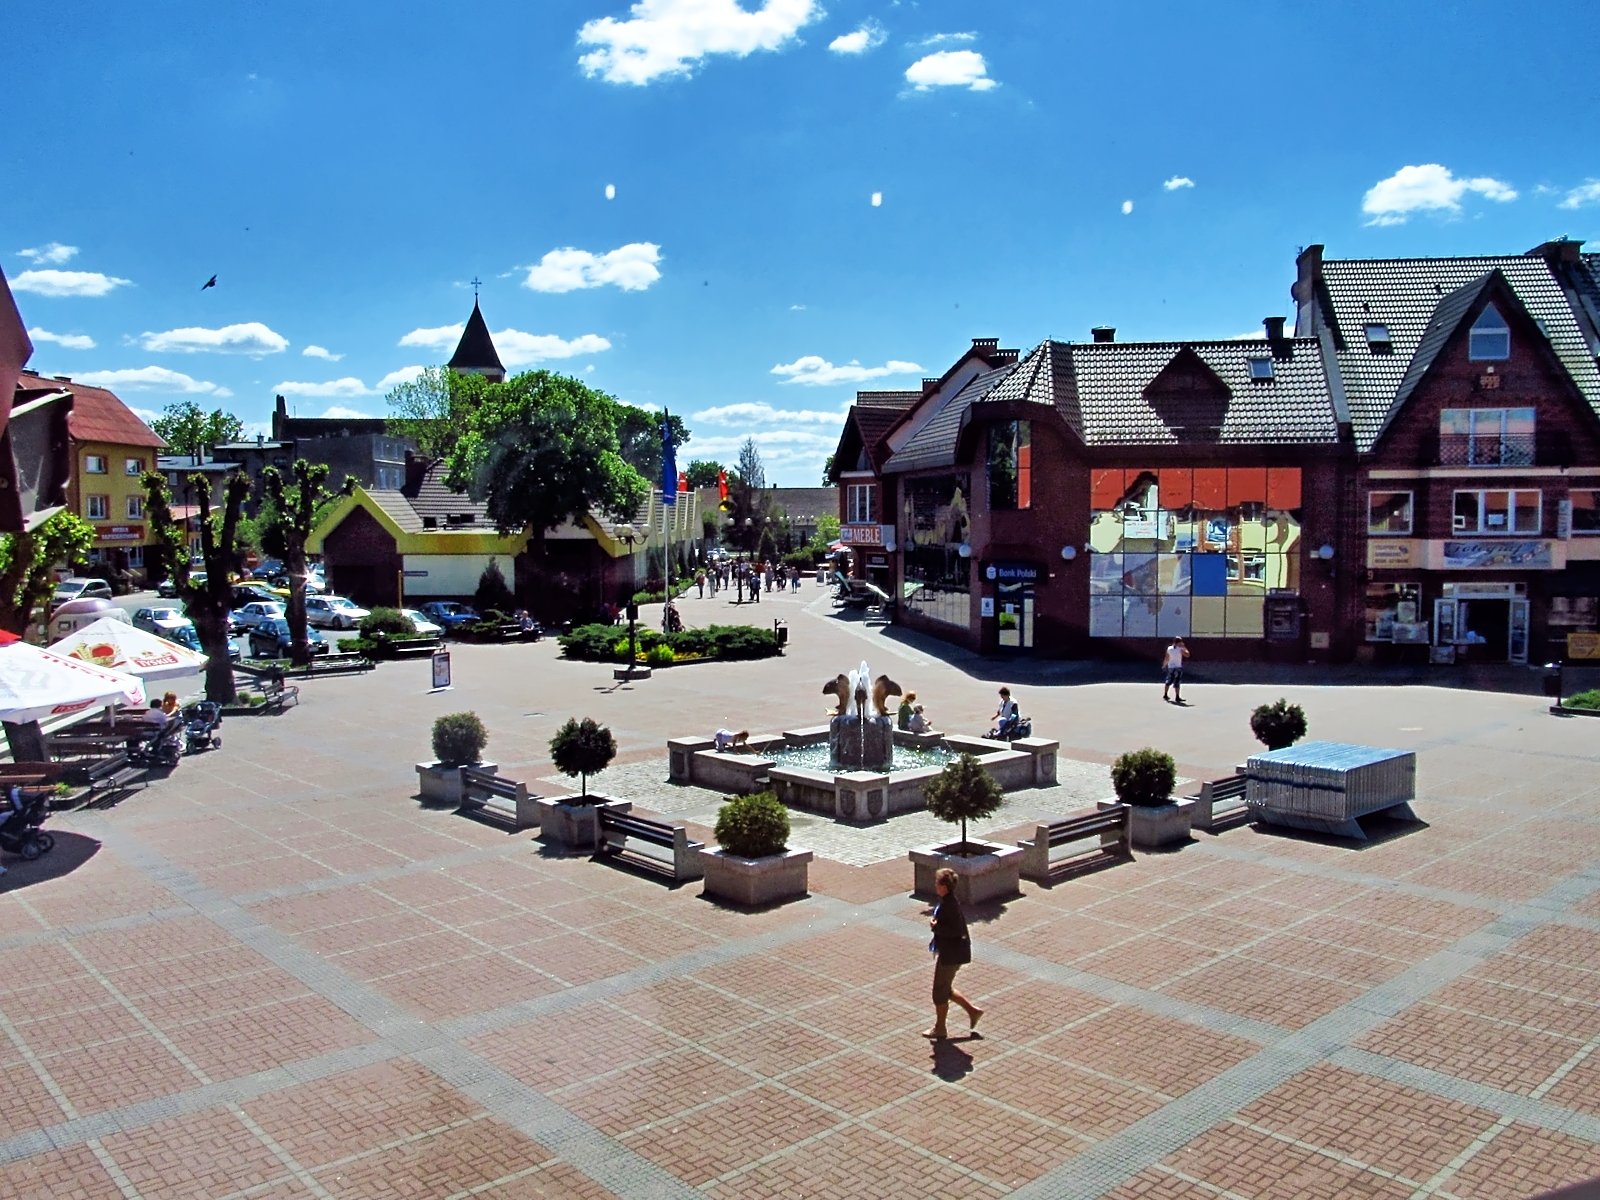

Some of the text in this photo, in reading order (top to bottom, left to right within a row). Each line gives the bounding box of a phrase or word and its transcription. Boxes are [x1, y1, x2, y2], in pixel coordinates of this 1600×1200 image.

[853, 528, 880, 543] MEBLE
[999, 568, 1036, 577] Bank Polski
[138, 656, 176, 667] TYSKIE
